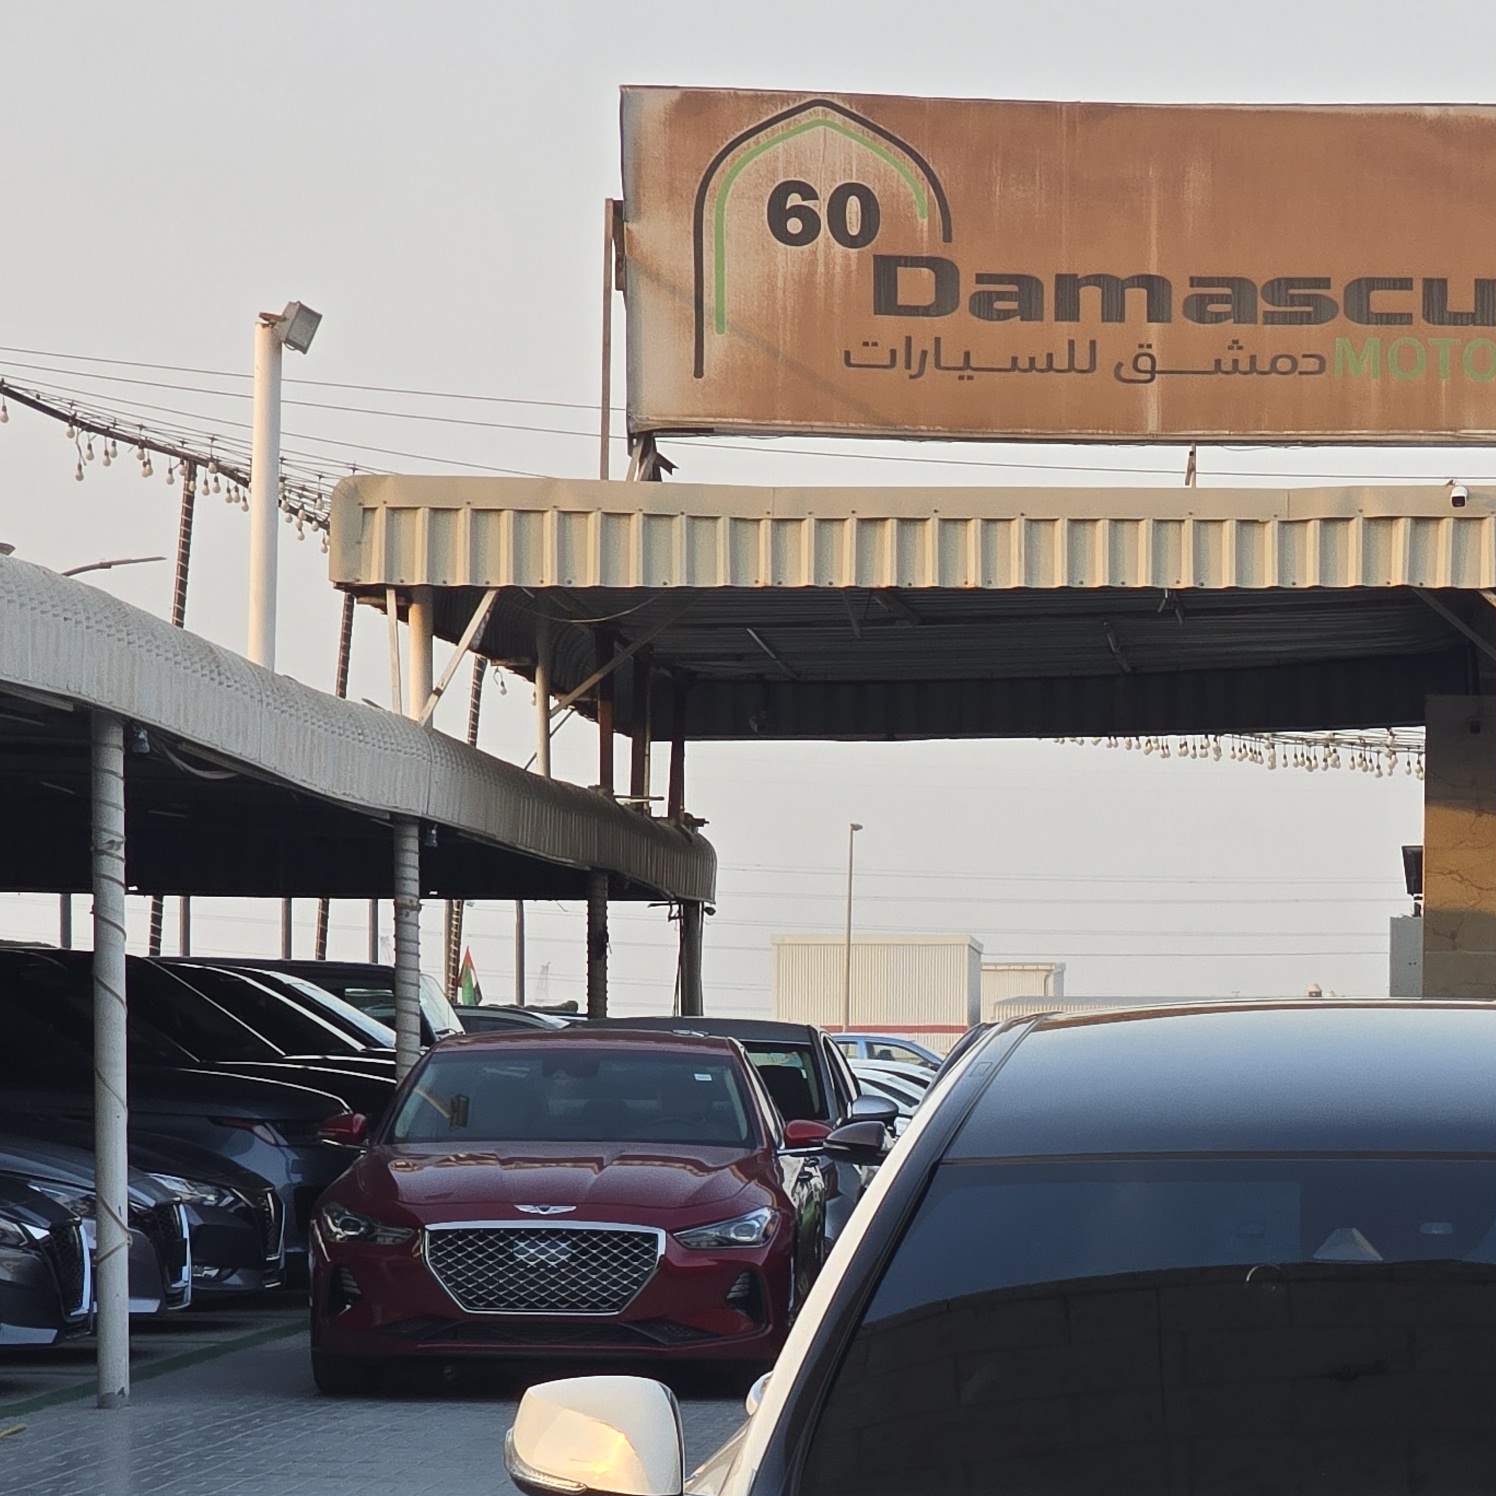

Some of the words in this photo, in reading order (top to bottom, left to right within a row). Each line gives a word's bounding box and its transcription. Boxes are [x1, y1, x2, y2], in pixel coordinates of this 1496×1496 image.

[767, 180, 880, 248] 60
[843, 336, 1098, 381] للسيارات
[1113, 338, 1327, 384] دمشق
